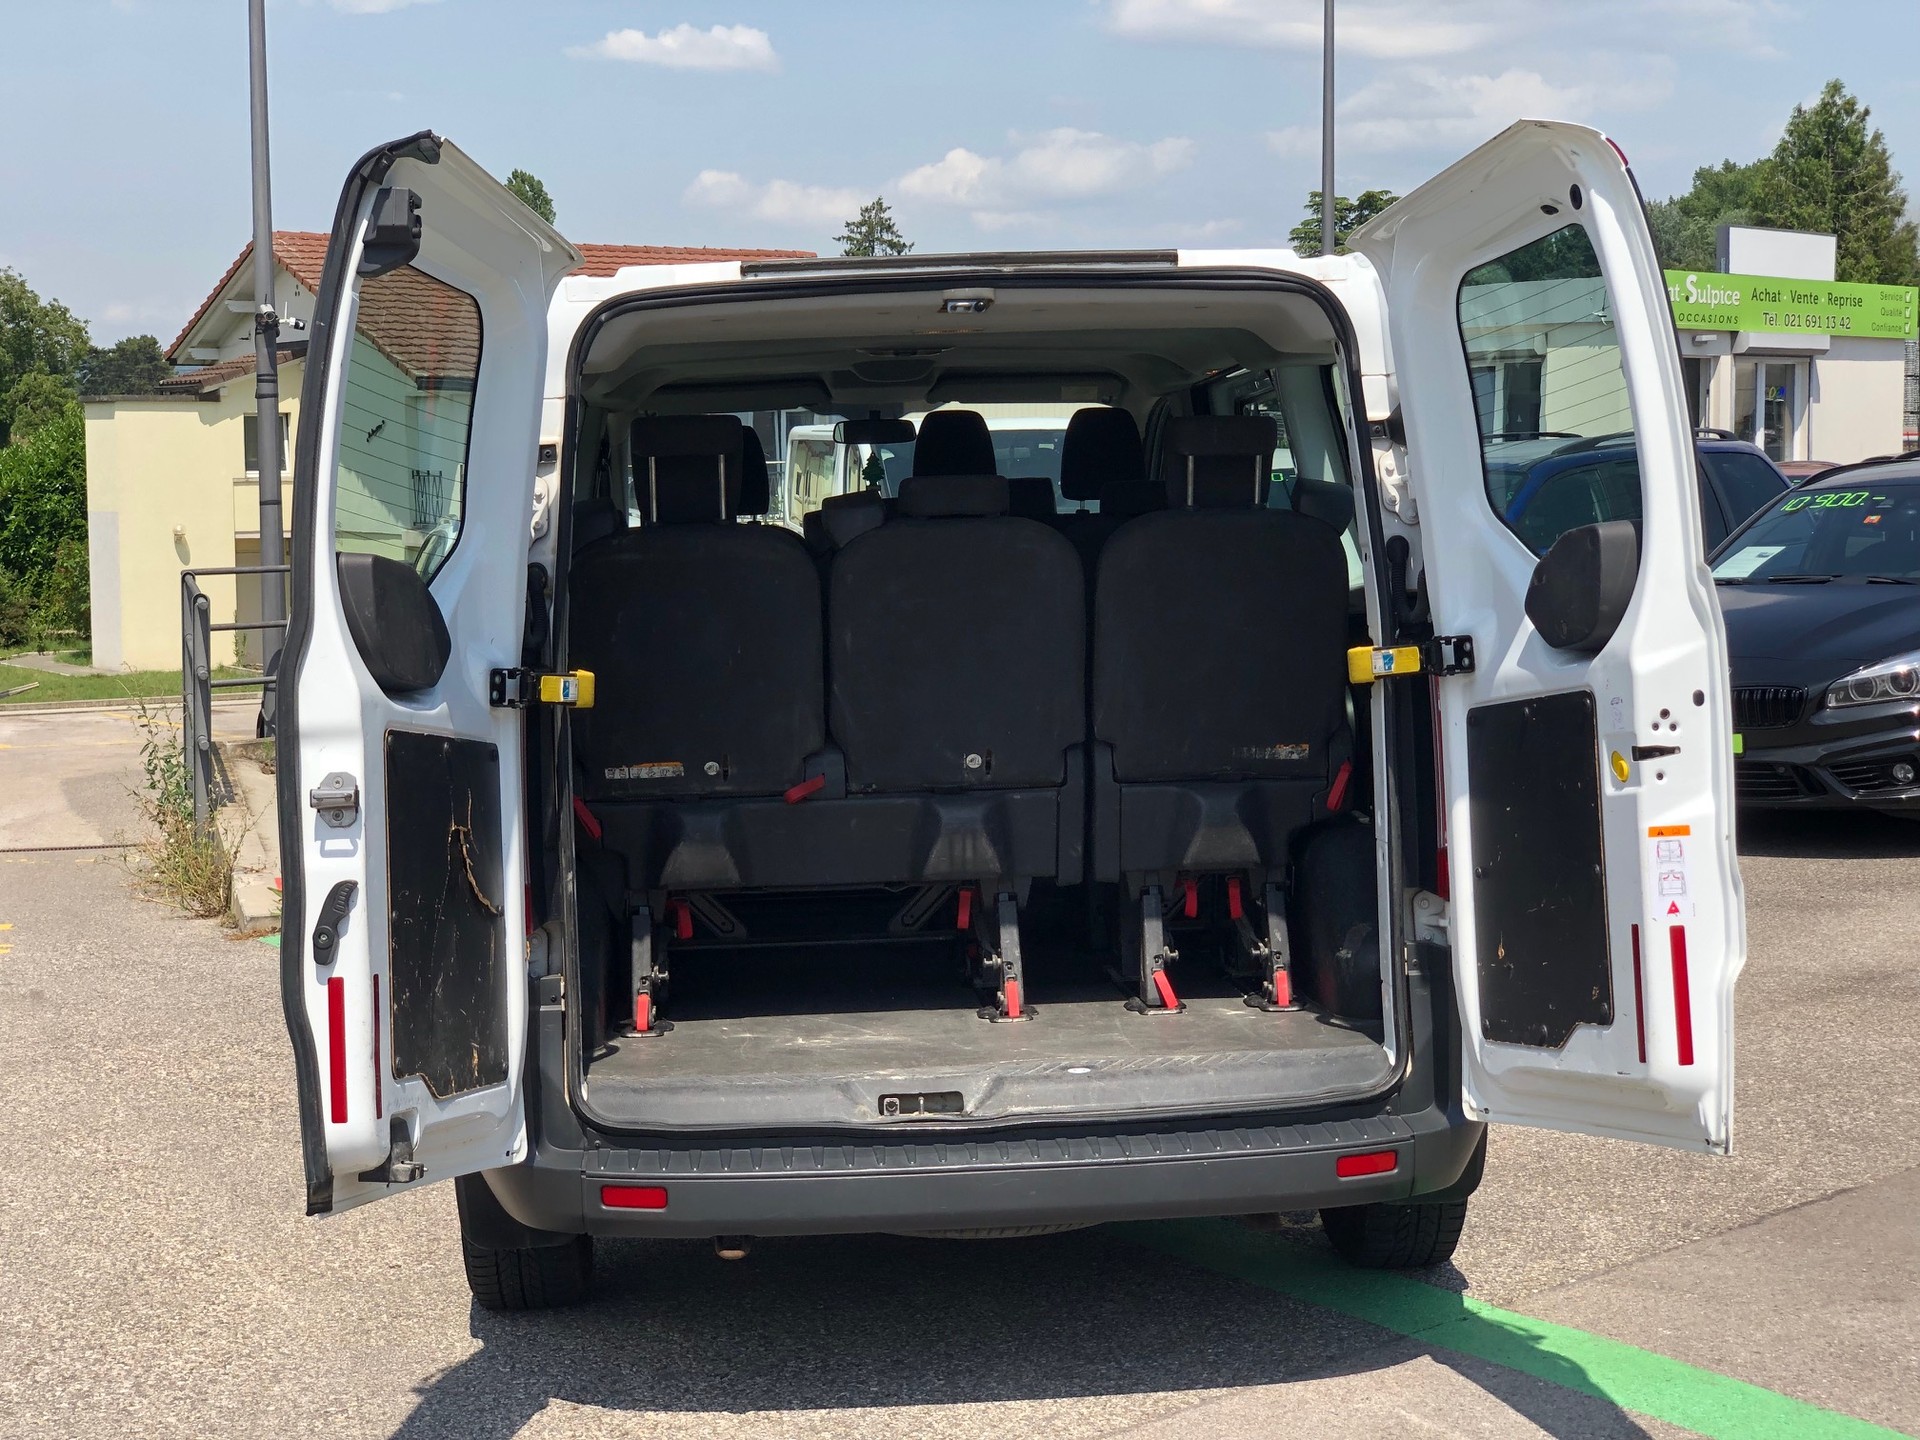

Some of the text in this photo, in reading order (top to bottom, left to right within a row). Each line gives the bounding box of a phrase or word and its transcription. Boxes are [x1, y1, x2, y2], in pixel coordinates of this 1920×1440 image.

[1751, 287, 1863, 309] Achat Vente Reprise
[1880, 291, 1903, 301] Service
[1678, 312, 1739, 324] OCCASIONS
[1784, 313, 1802, 328] 021
[1805, 314, 1822, 329] 691
[1826, 315, 1836, 329] 13
[1839, 316, 1851, 330] 42
[1871, 322, 1902, 333] Confiance
